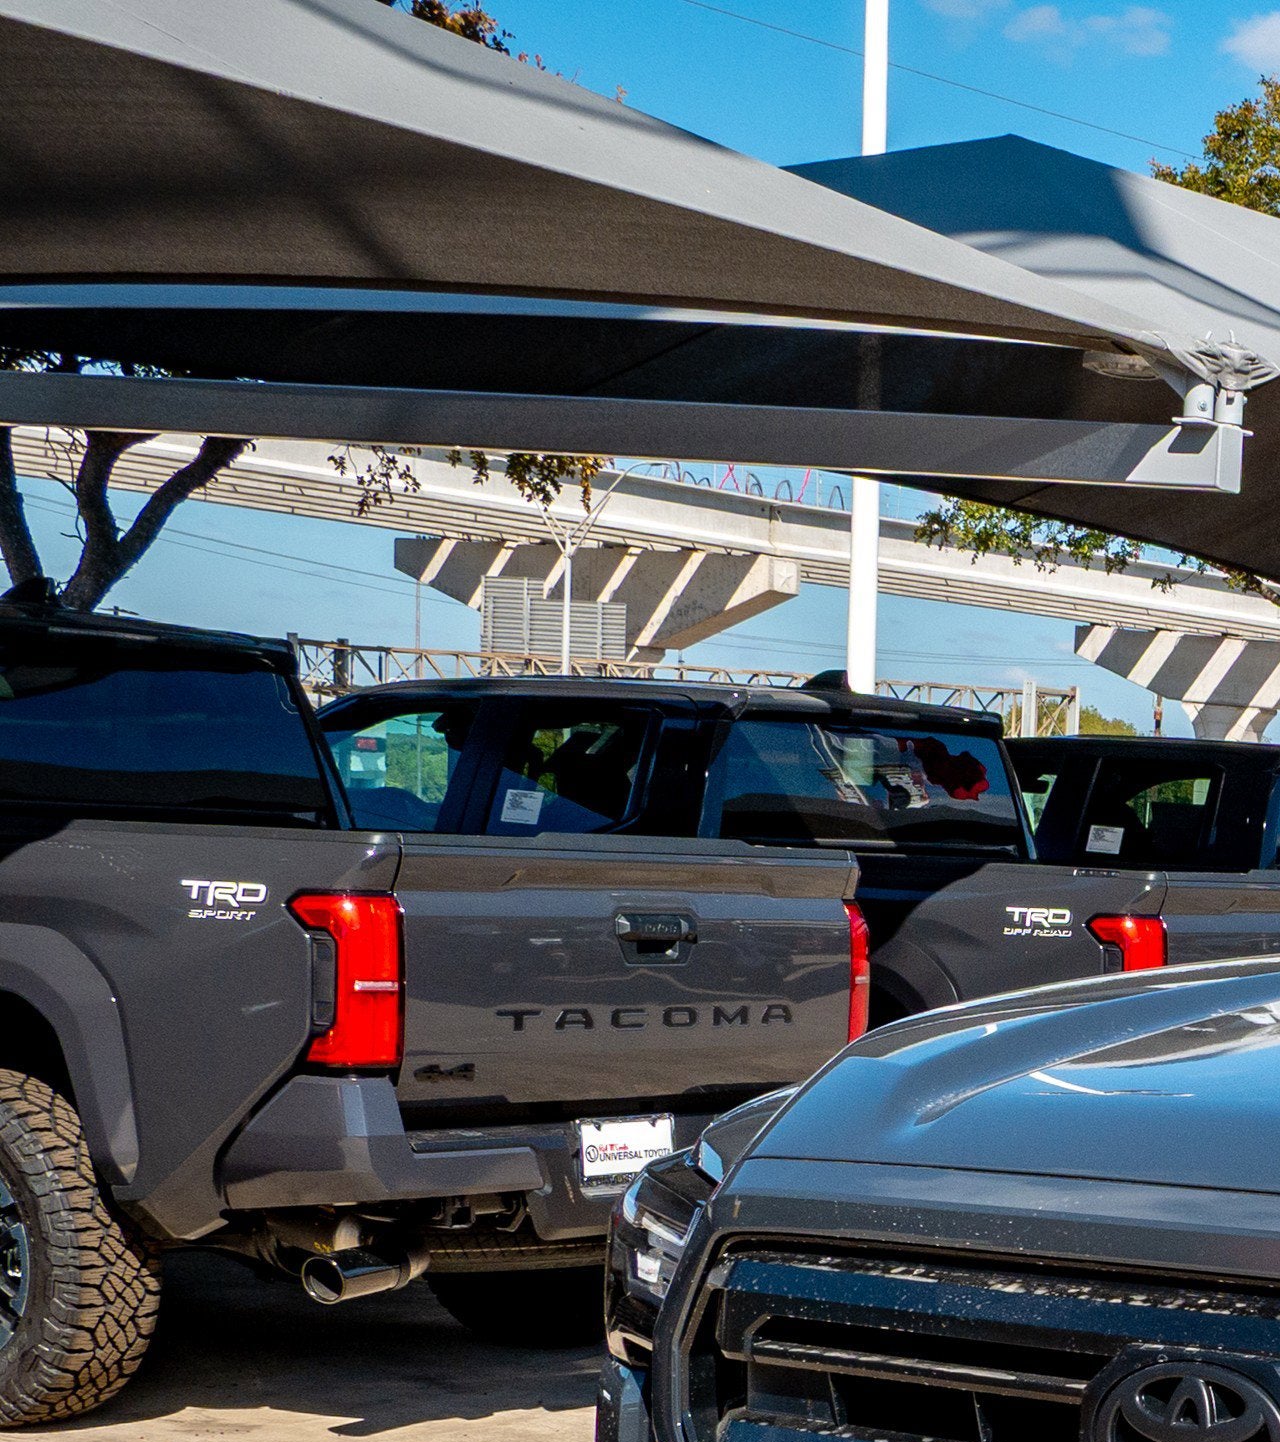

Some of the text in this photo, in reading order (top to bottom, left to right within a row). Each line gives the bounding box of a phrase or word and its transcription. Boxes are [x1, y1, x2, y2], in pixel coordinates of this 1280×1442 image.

[180, 879, 268, 907] TRD
[187, 909, 256, 921] SPORT
[1005, 906, 1072, 928] TRD
[496, 1003, 793, 1032] TACOMA
[599, 1151, 643, 1161] UNIVERSAL
